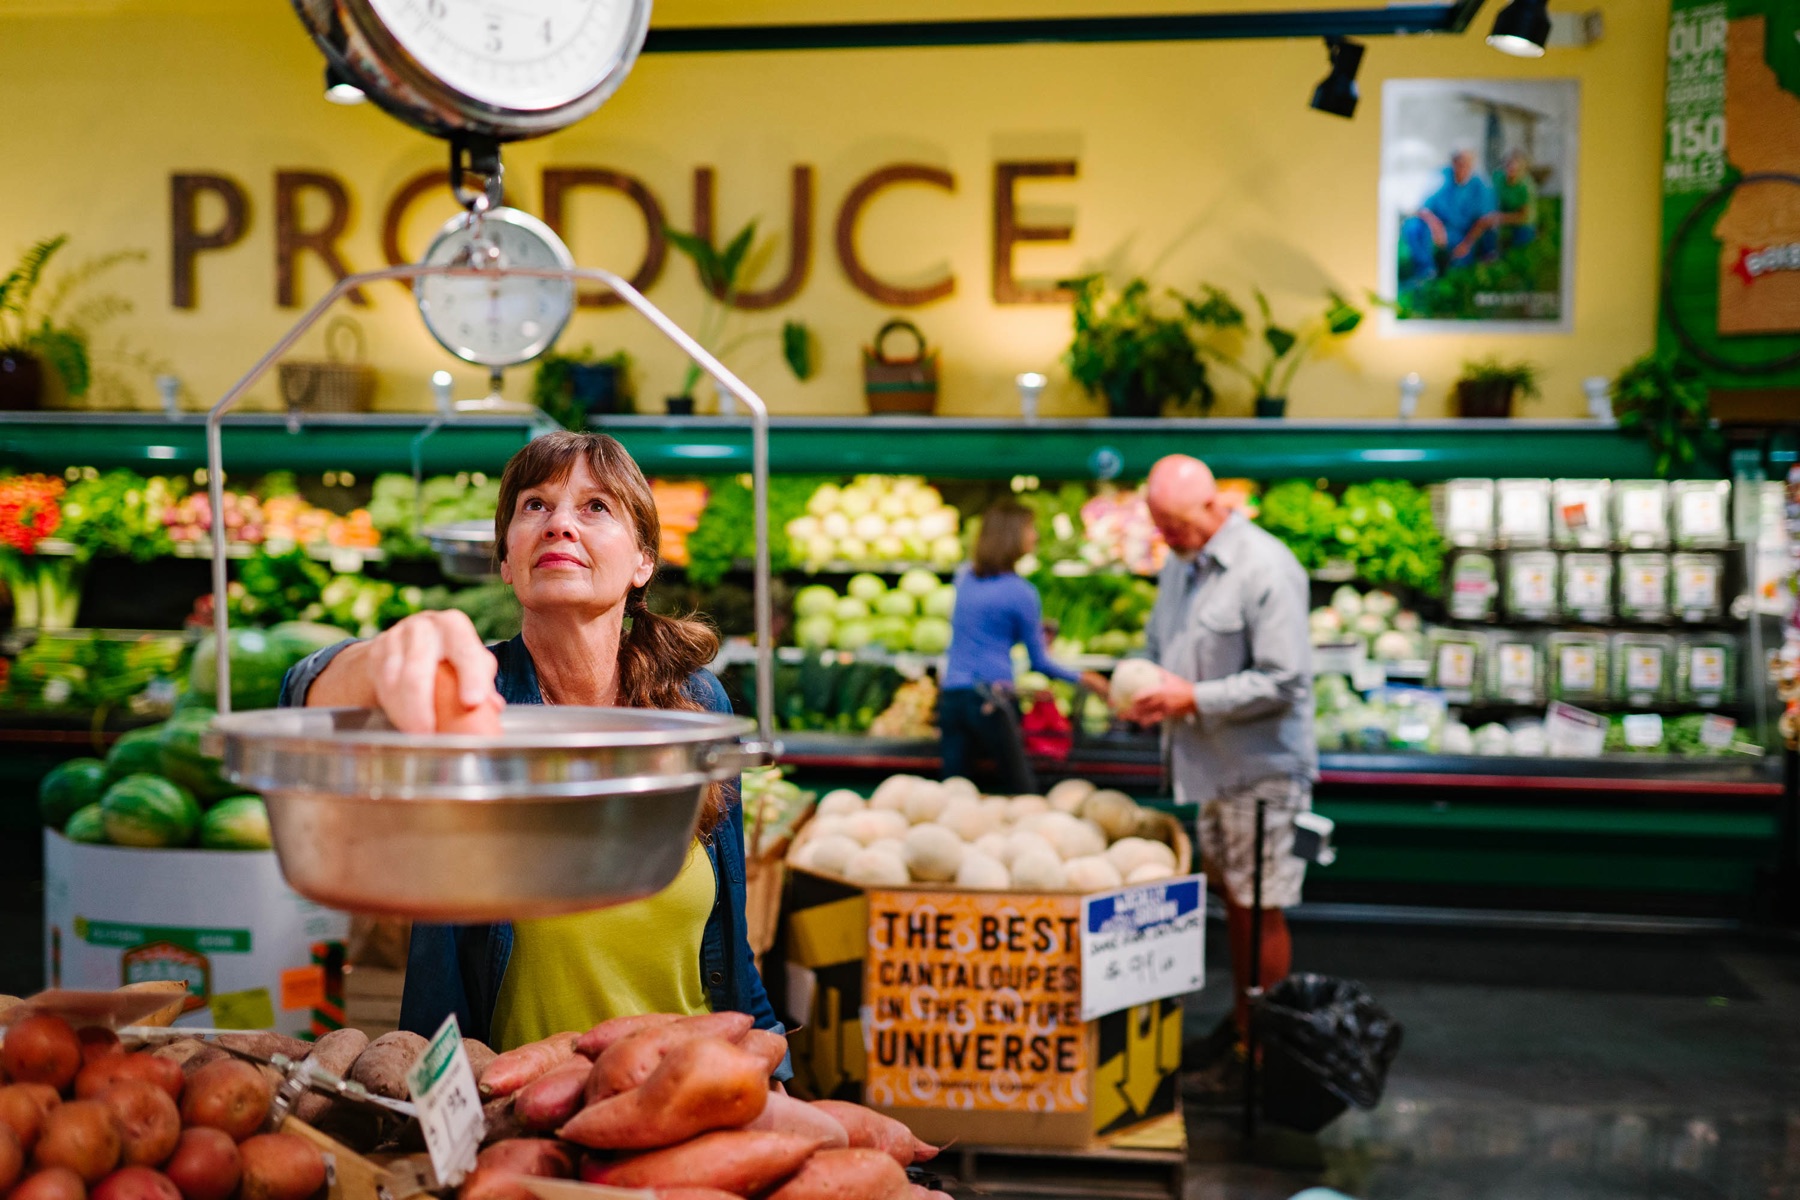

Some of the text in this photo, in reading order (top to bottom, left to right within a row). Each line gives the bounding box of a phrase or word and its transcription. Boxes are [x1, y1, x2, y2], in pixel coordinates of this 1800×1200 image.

[1668, 115, 1727, 157] 150
[169, 161, 1080, 310] PRODUCE
[880, 911, 954, 950] THE
[980, 915, 1079, 953] BEST
[879, 959, 1081, 993] CANTALOUPES
[877, 996, 1080, 1027] IN THE ENTIRE
[876, 1030, 1079, 1073] UNIVERSE
